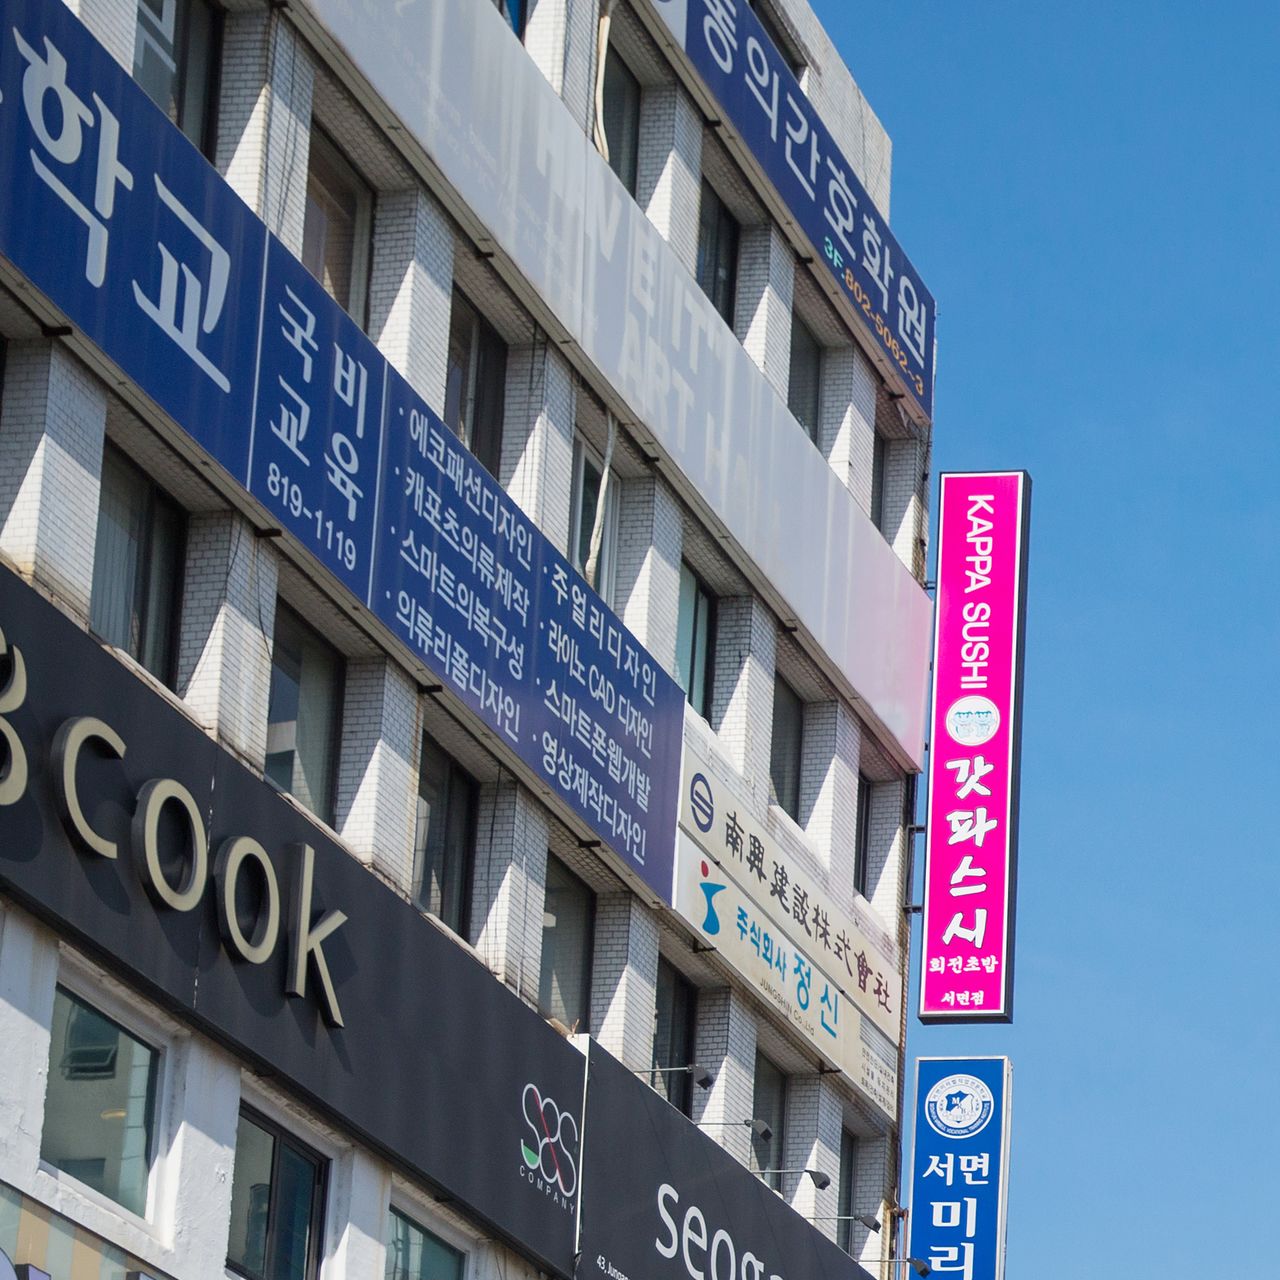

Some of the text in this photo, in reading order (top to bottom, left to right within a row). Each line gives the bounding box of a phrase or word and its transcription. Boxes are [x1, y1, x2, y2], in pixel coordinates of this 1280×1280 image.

[13, 27, 231, 394] 학교
[279, 286, 367, 438] 국비
[267, 462, 356, 571] 819-1119
[270, 376, 363, 521] 교육
[409, 409, 532, 571] 에코패션디자인
[400, 529, 524, 680] 스마트의복구성
[960, 495, 995, 689] KAPPA SUSHI
[396, 590, 520, 742] 의류리폼디자인
[549, 619, 653, 760] 라이노 CAD 디자인
[542, 730, 645, 866] 영상제작디자인
[543, 683, 651, 813] 스마트폰웹개발
[942, 755, 998, 949] 갓파스시
[736, 905, 838, 1038] 주식회사 정신
[929, 954, 998, 975] 회전초밥
[940, 991, 985, 1006] 서면점
[520, 1165, 575, 1215] COMPANY
[922, 1152, 990, 1187] 서면
